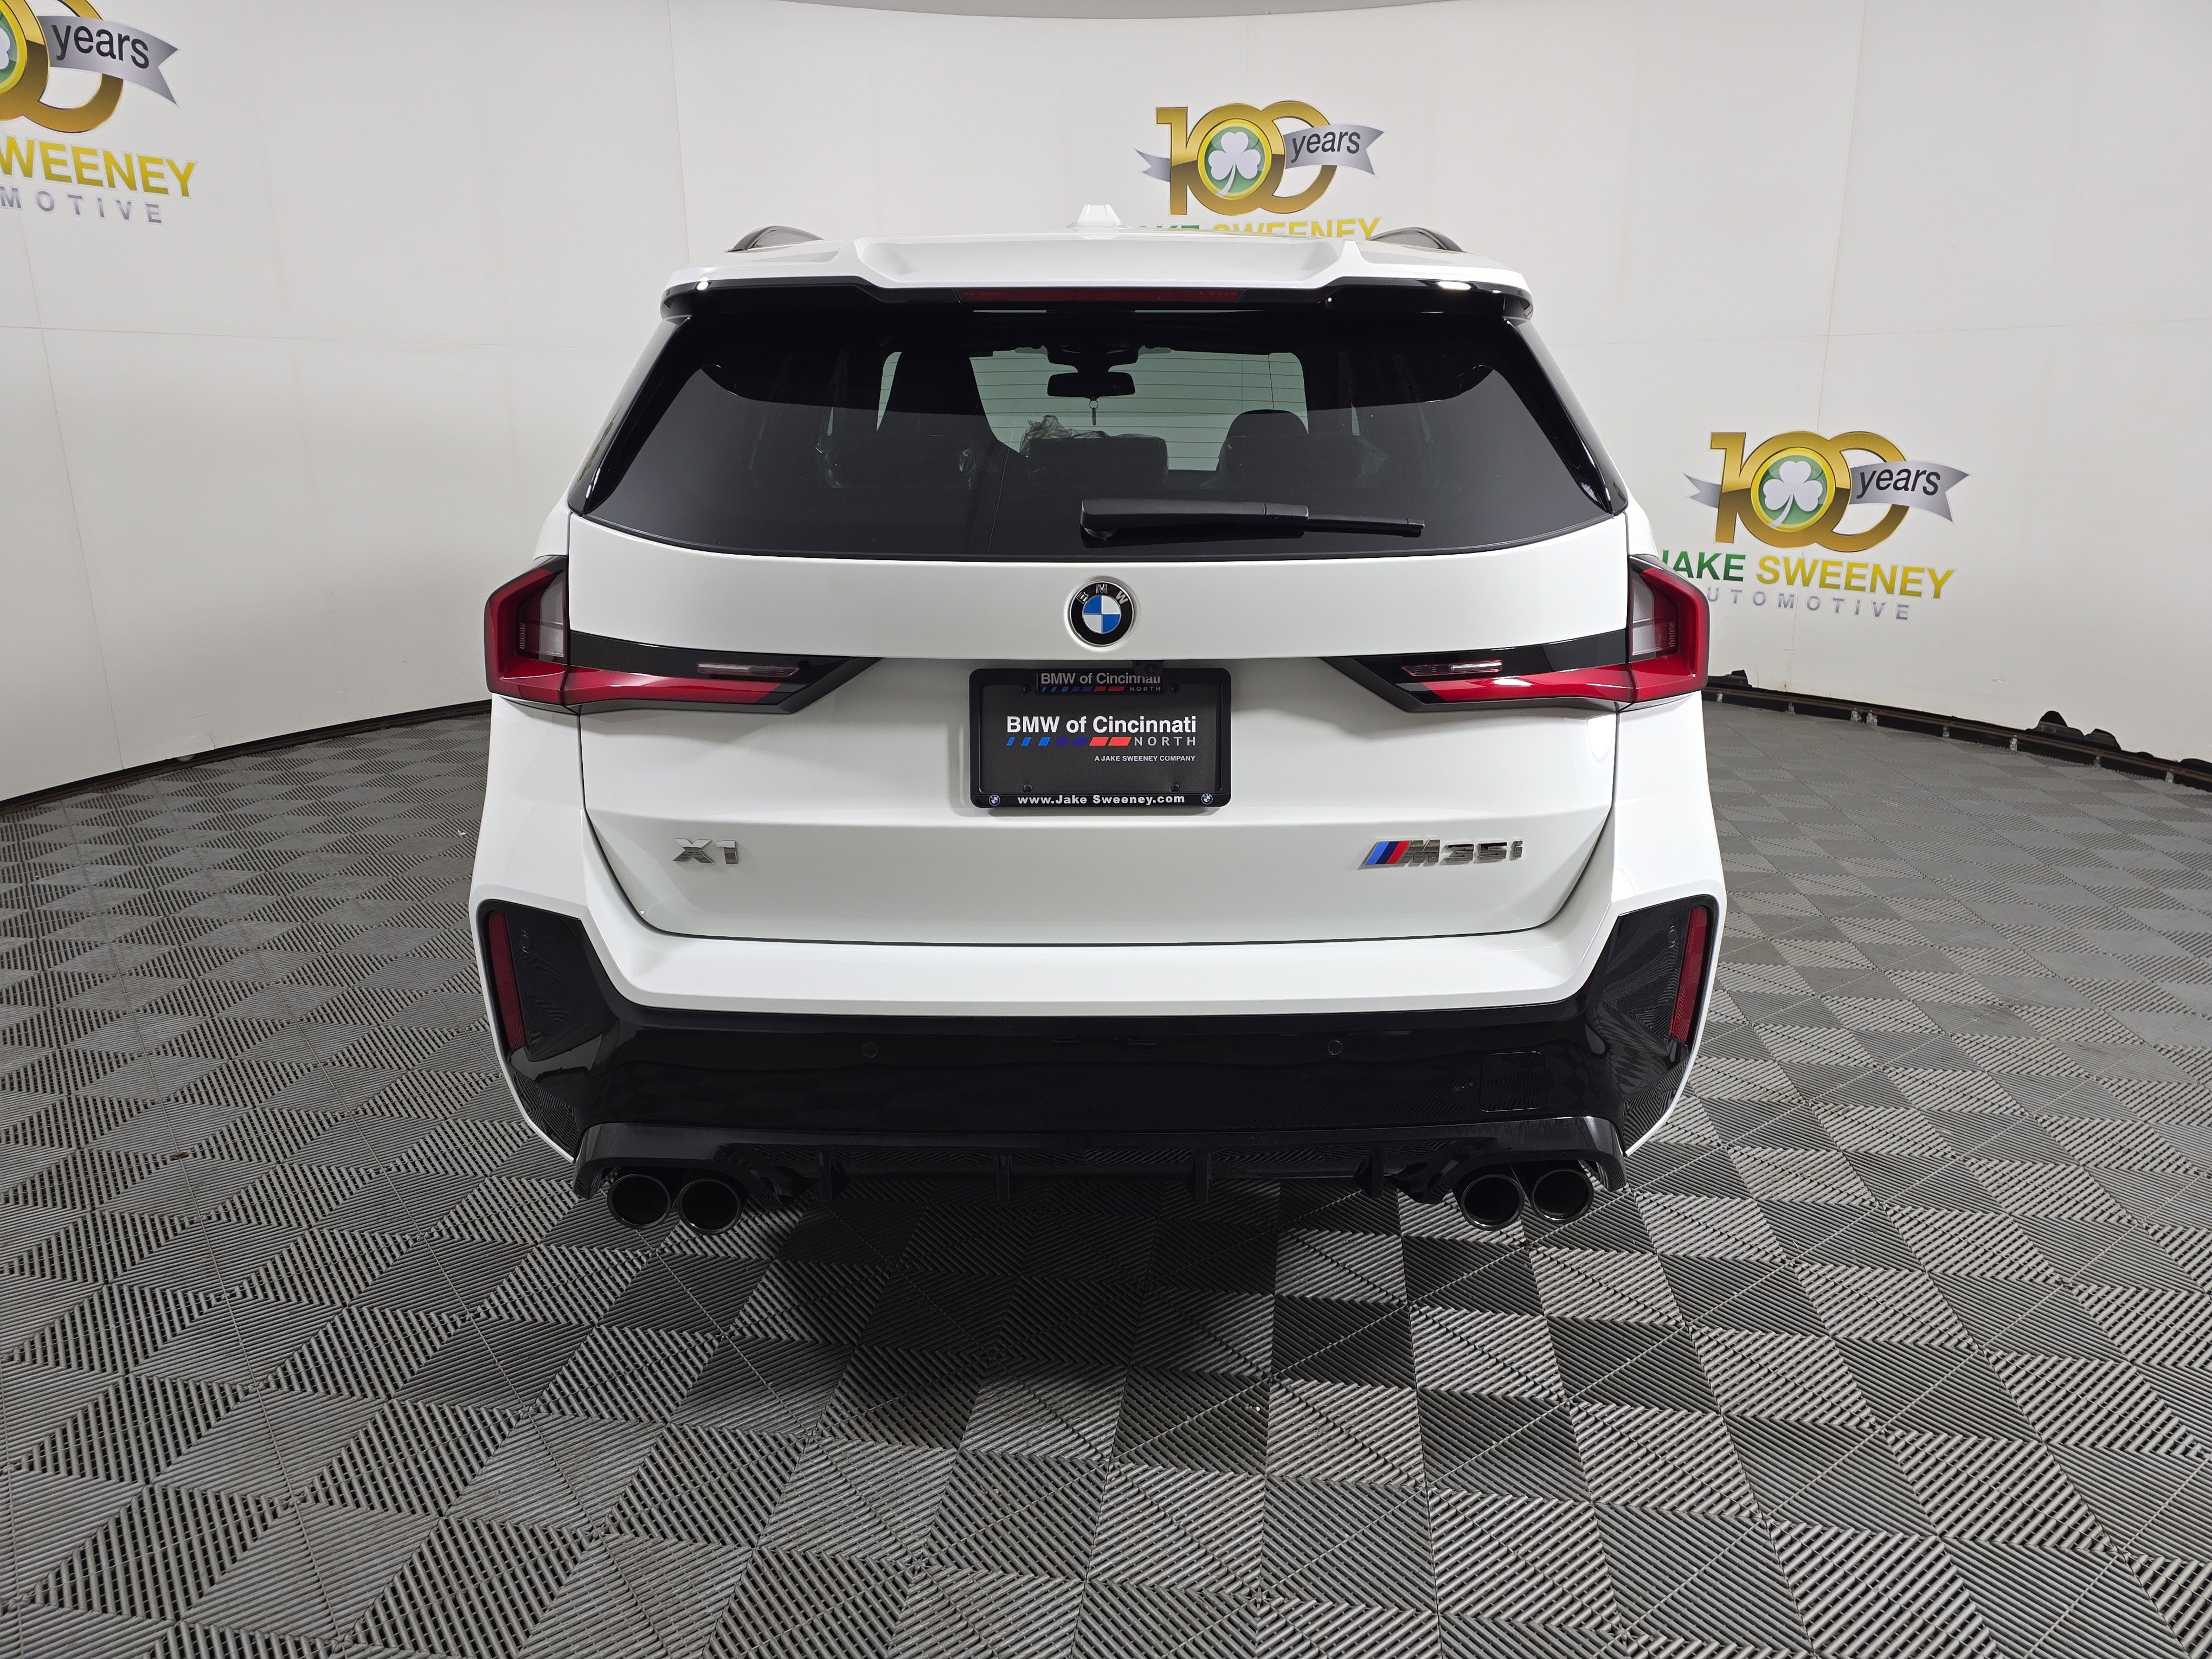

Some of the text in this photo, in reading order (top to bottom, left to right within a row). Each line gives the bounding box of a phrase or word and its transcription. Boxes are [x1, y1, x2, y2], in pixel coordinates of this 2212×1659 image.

[51, 24, 149, 69] years
[1155, 100, 1337, 215] 100
[1291, 131, 1361, 163] years
[1212, 216, 1380, 240] ENEY
[1710, 431, 1909, 552] 100
[1856, 467, 1941, 499] years
[1756, 555, 1954, 600] SWEENEY
[1076, 583, 1128, 605] BMW
[1041, 673, 1076, 684] BMW
[1079, 673, 1093, 684] of
[1007, 716, 1196, 733] BMW of Cincinnati
[1134, 736, 1195, 746] NORTH
[1018, 794, 1185, 806] www.Jake Sweeney.com
[673, 838, 738, 864] X1
